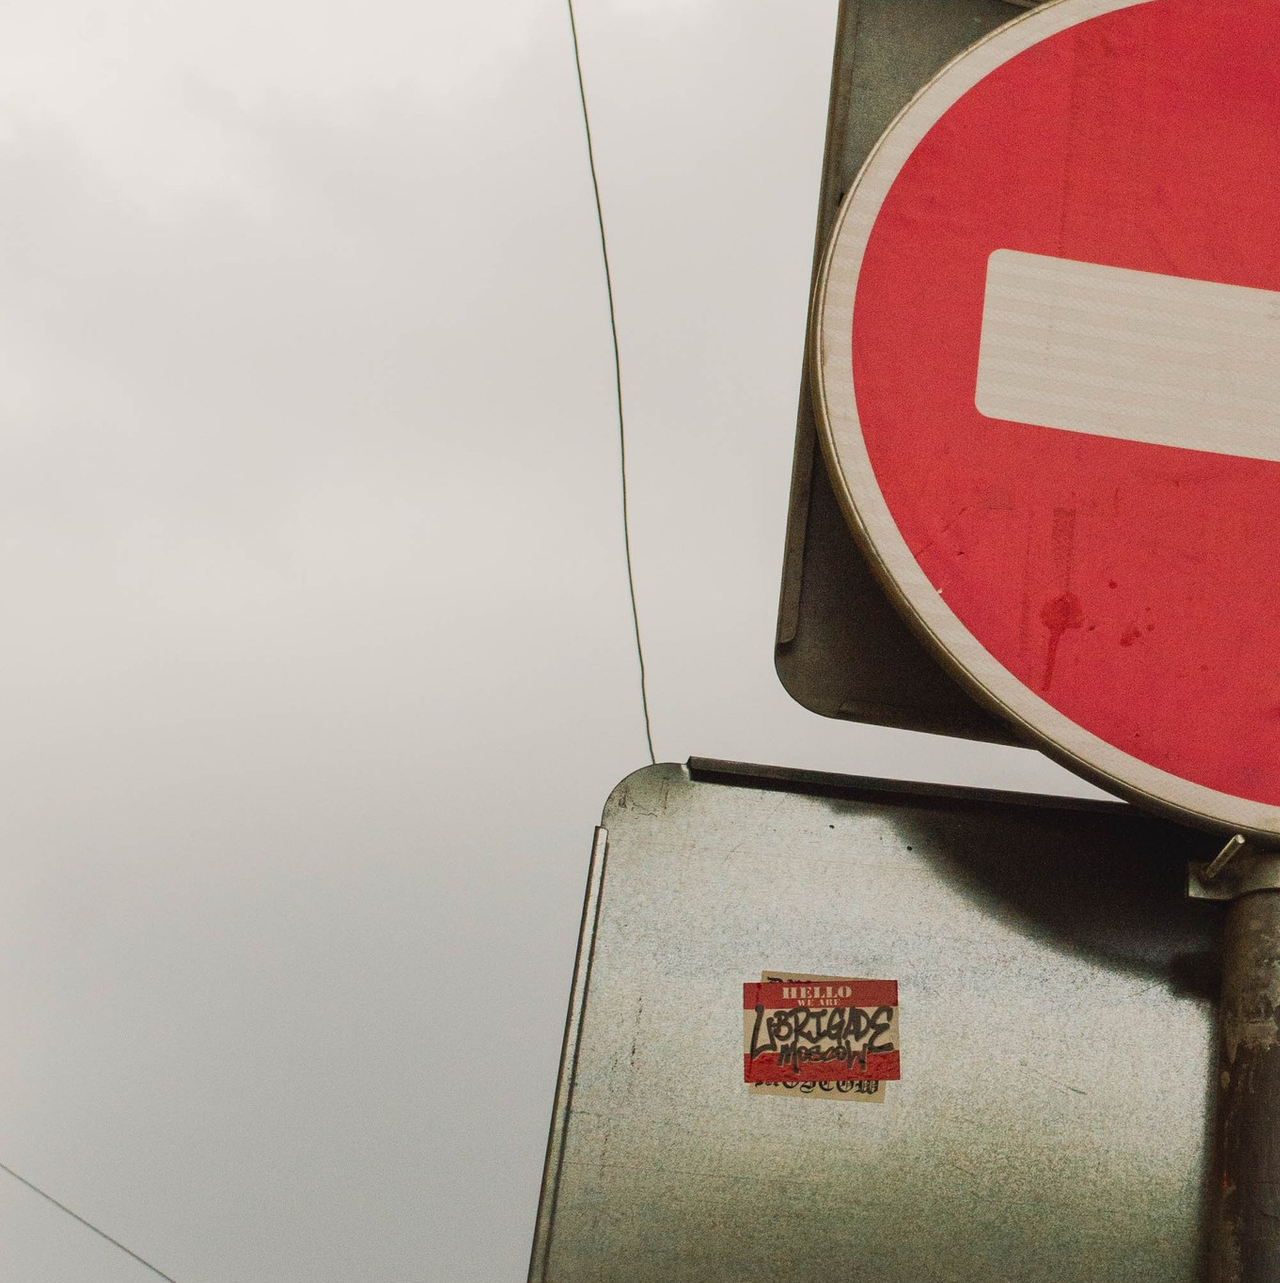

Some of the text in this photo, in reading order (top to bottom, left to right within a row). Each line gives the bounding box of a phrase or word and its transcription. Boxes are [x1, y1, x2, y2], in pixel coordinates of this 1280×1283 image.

[782, 986, 852, 999] HELLO
[797, 998, 841, 1007] WE ARE
